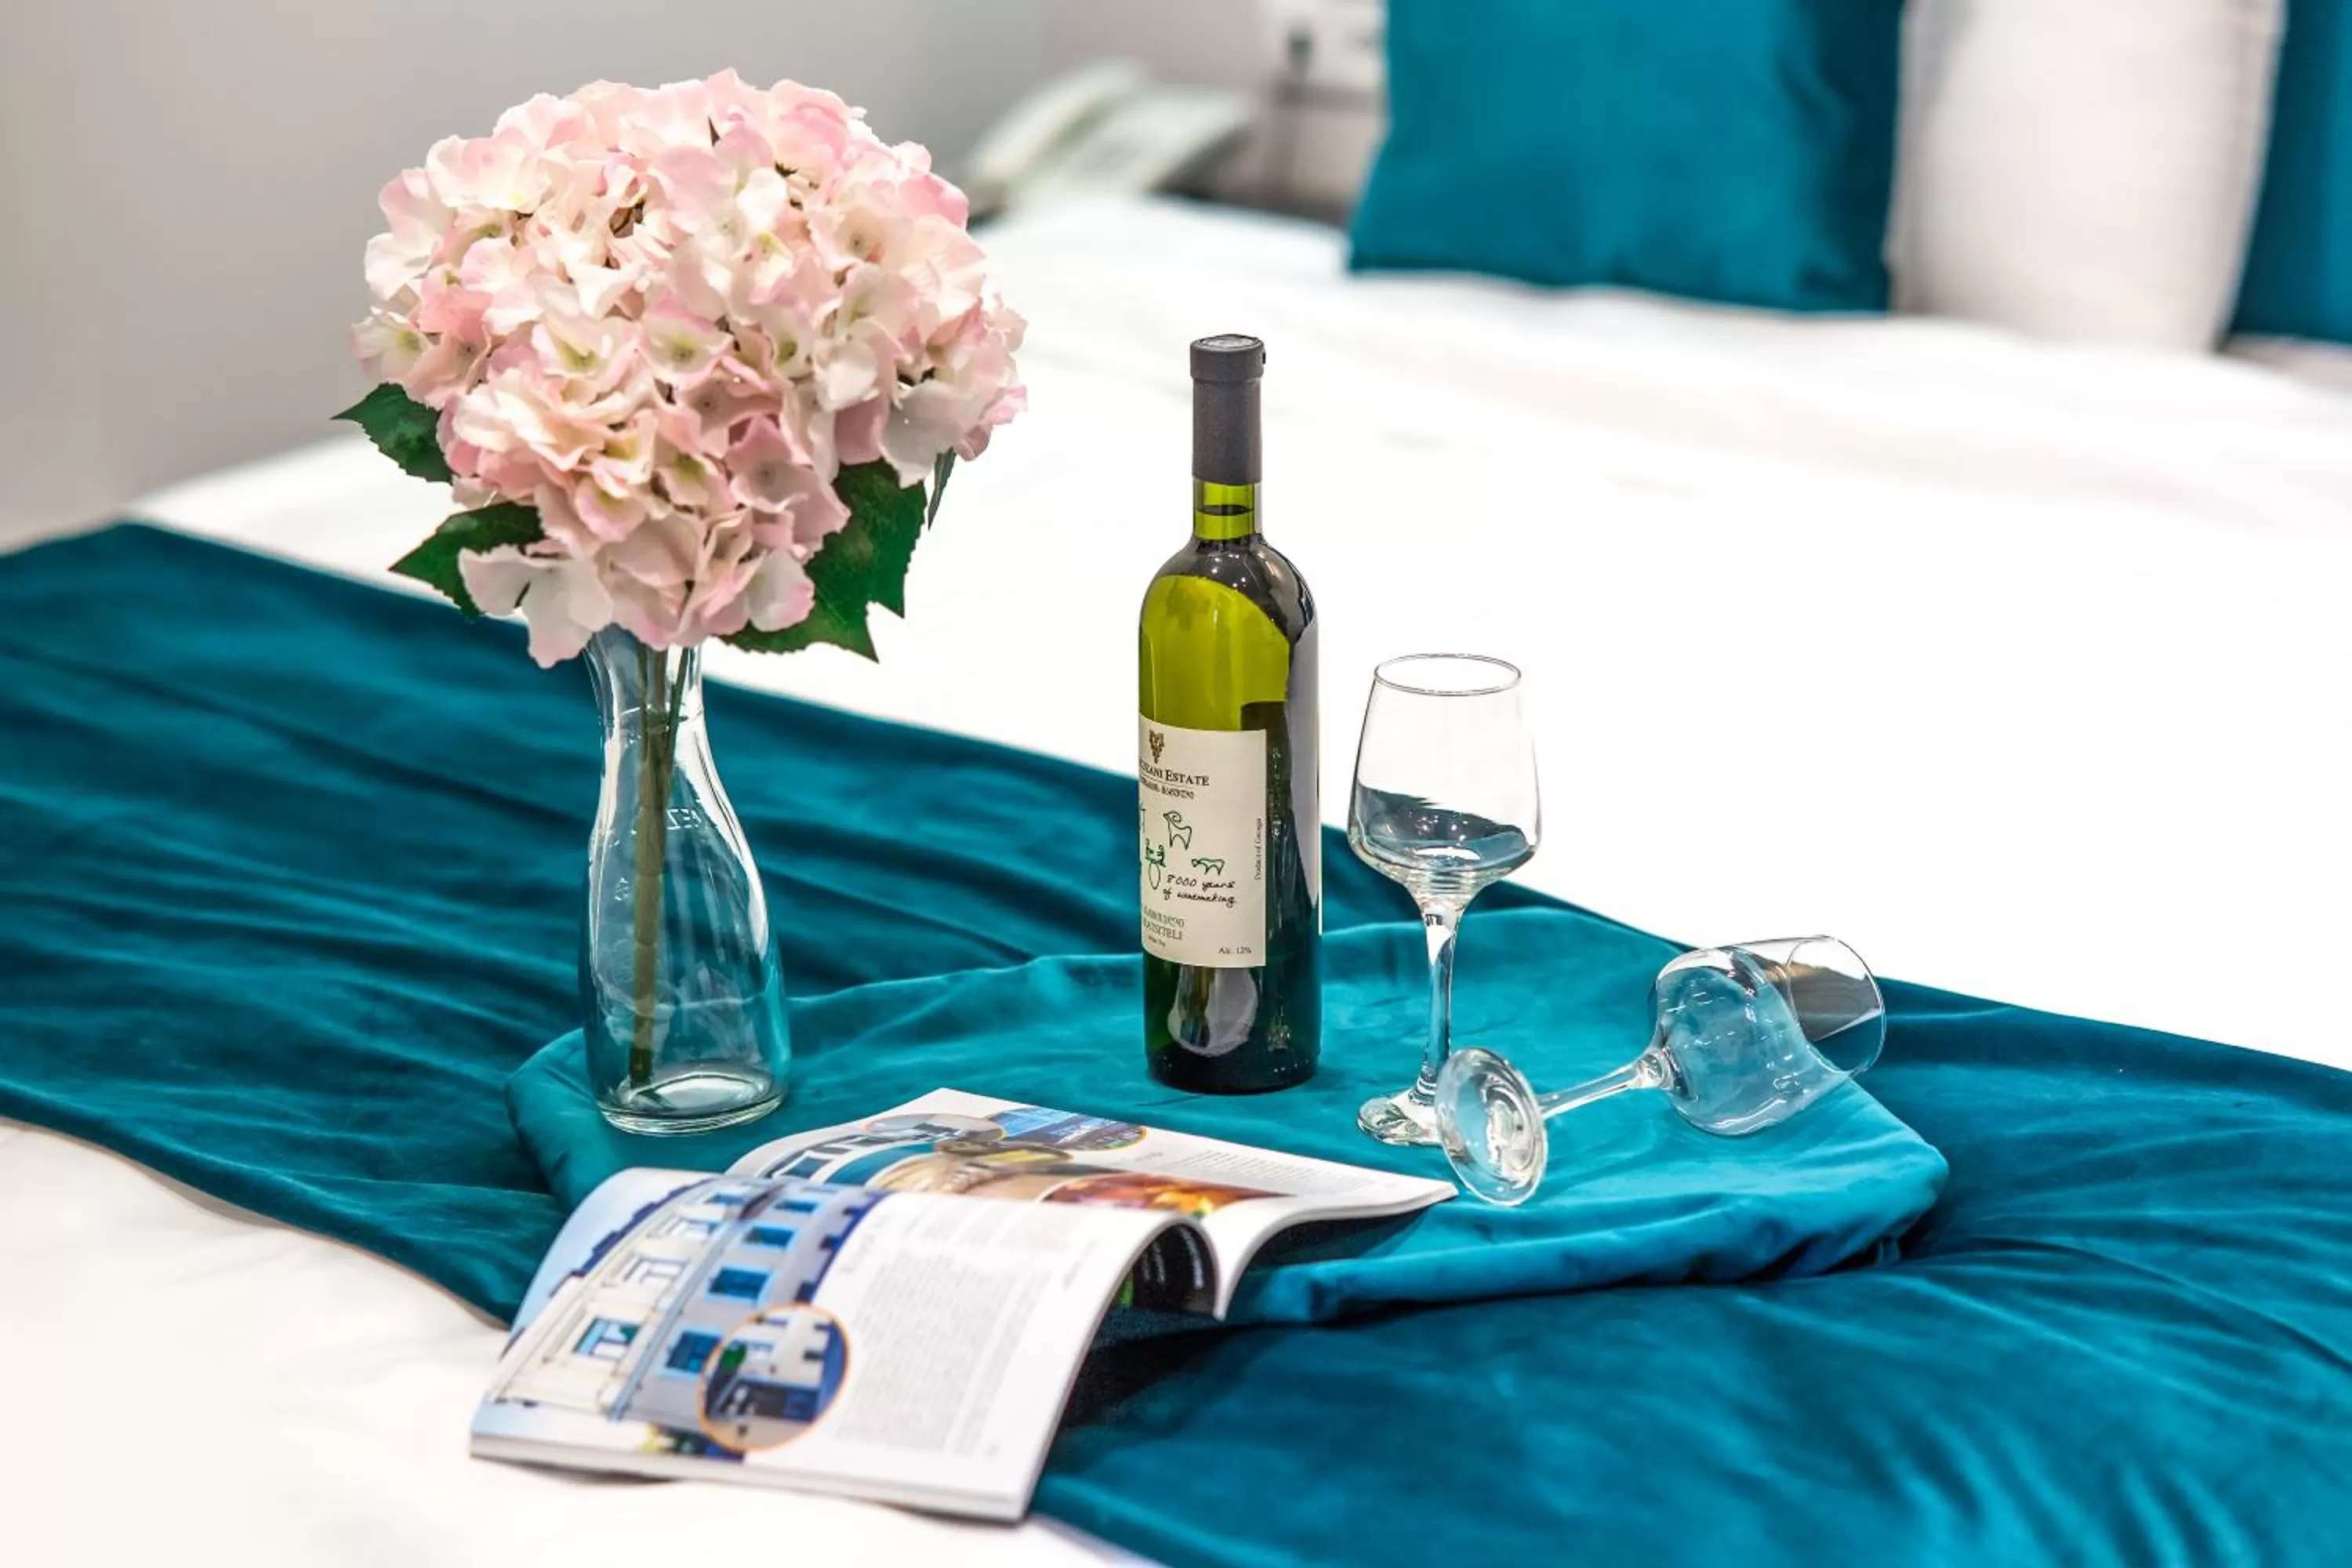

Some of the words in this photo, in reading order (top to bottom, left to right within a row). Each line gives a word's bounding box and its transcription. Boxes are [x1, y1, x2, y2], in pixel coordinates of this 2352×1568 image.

[1165, 769, 1210, 786] ESTATE
[1167, 874, 1196, 886] 8000
[1202, 880, 1236, 892] years
[1177, 891, 1237, 908] winemaking
